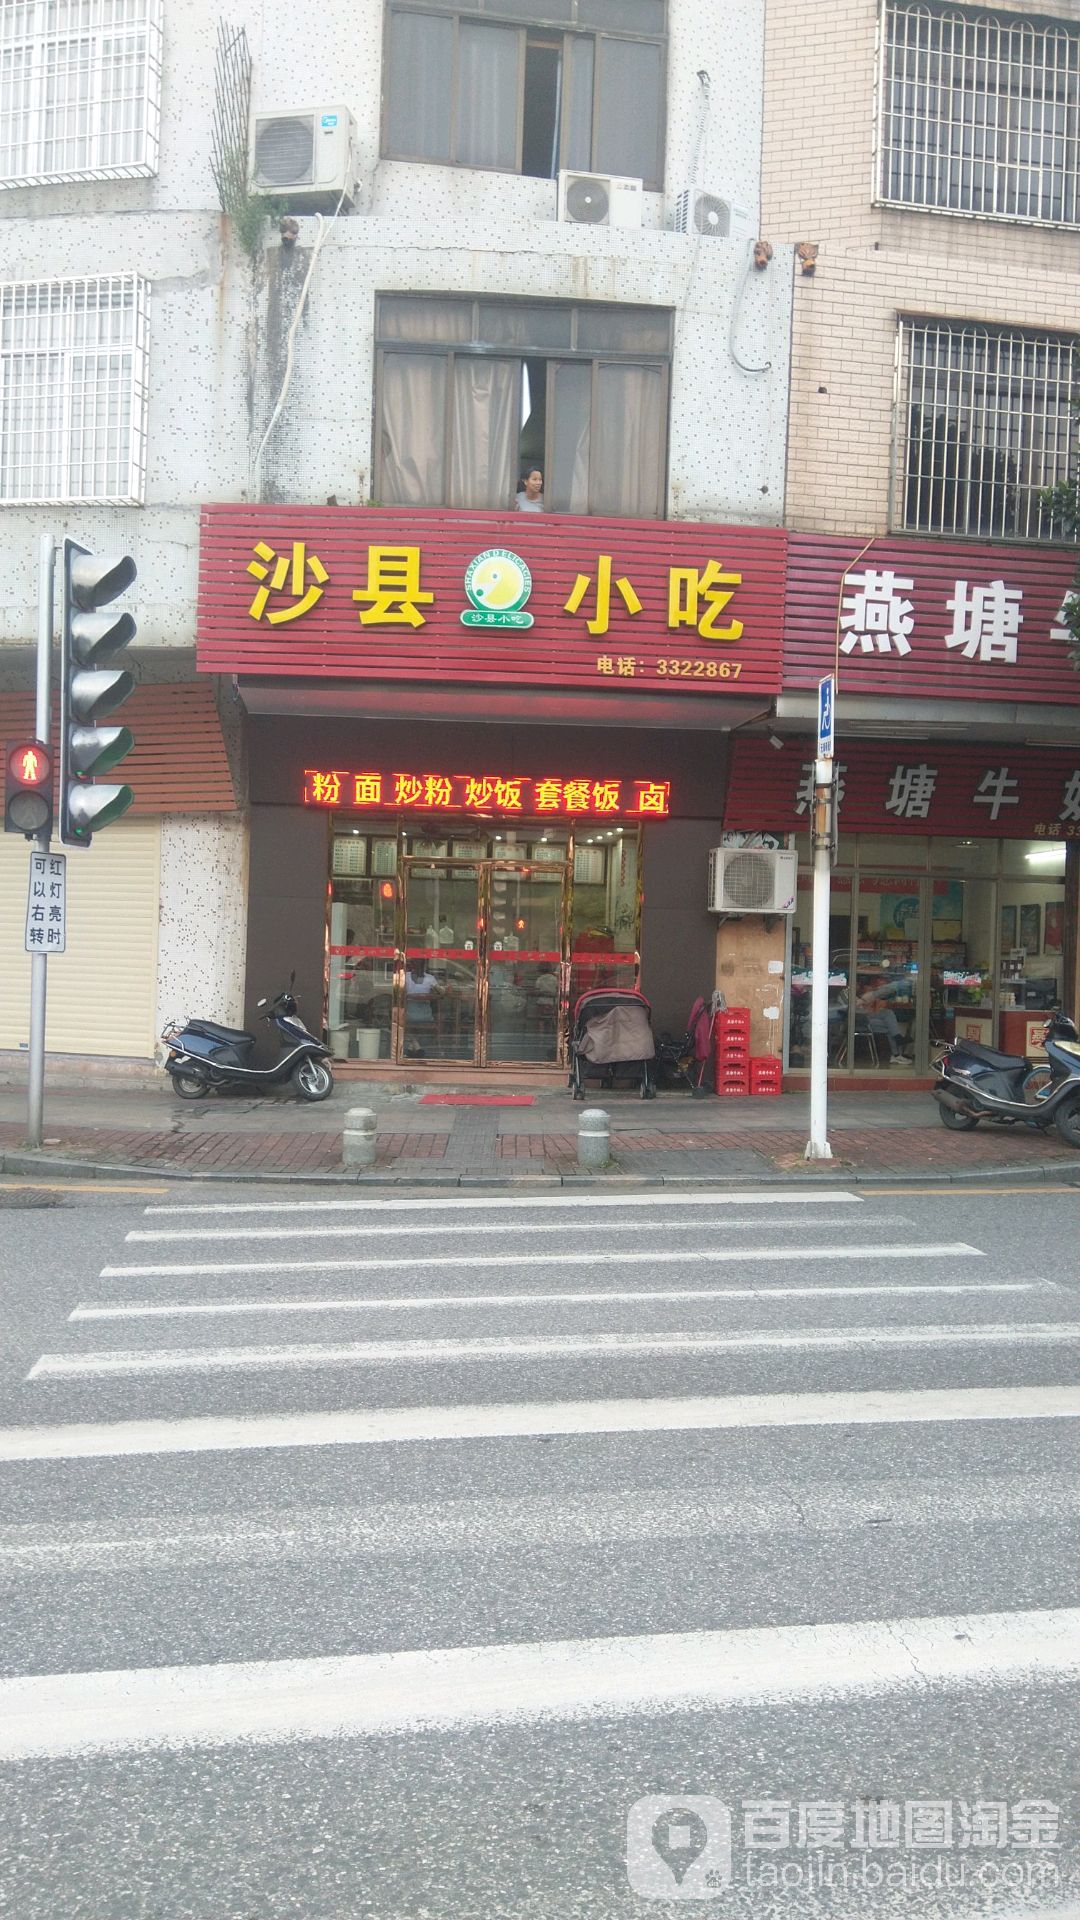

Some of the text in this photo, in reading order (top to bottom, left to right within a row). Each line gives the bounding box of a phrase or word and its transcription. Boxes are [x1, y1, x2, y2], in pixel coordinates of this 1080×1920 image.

[246, 541, 744, 641] 沙县 小吃
[466, 551, 492, 591] SHAXIAN
[471, 613, 525, 625] 沙县小吃
[656, 659, 742, 679] 3322867
[312, 772, 666, 812] 粉 面 炒粉 炒饭 套餐饭 卤
[1034, 822, 1061, 836] 电话
[29, 857, 47, 945] 可以右转
[47, 858, 62, 945] 红灯亮时
